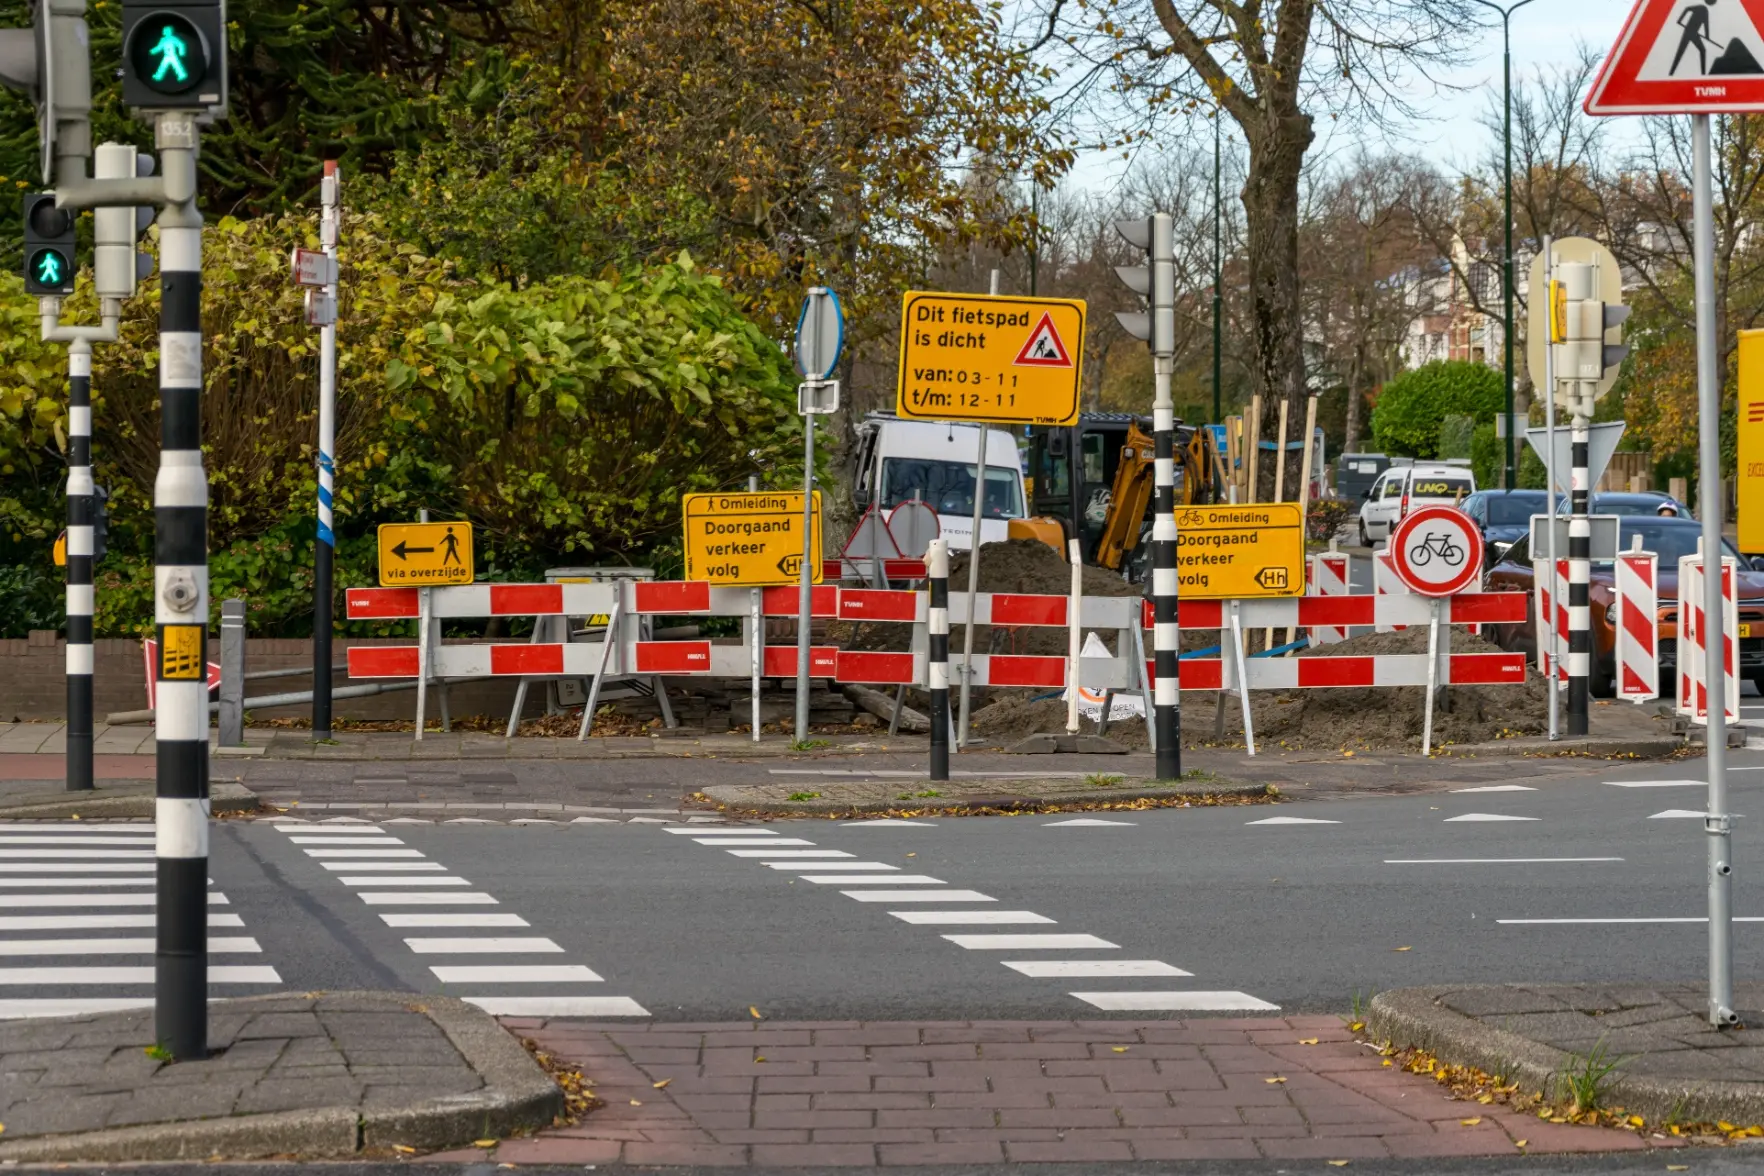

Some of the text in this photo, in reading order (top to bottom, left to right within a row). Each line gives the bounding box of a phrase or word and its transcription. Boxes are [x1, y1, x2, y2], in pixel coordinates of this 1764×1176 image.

[1694, 86, 1726, 97] TVMH
[917, 305, 1030, 328] Dit fietspad
[915, 330, 986, 349] is dicht
[914, 368, 953, 383] van:
[912, 388, 952, 407] t/m:
[1416, 482, 1449, 494] LNQ
[720, 497, 787, 510] Omleiding
[1208, 513, 1270, 525] Omleiding
[705, 518, 791, 536] Doorgaand
[942, 528, 972, 536] TEDIN
[1177, 531, 1258, 547] Doorgaand
[706, 541, 766, 556] verkeer
[1177, 553, 1235, 566] verkeer
[388, 567, 467, 579] via overzijde
[707, 563, 739, 579] volg
[1178, 573, 1209, 587] volg
[1264, 572, 1285, 585] Hh
